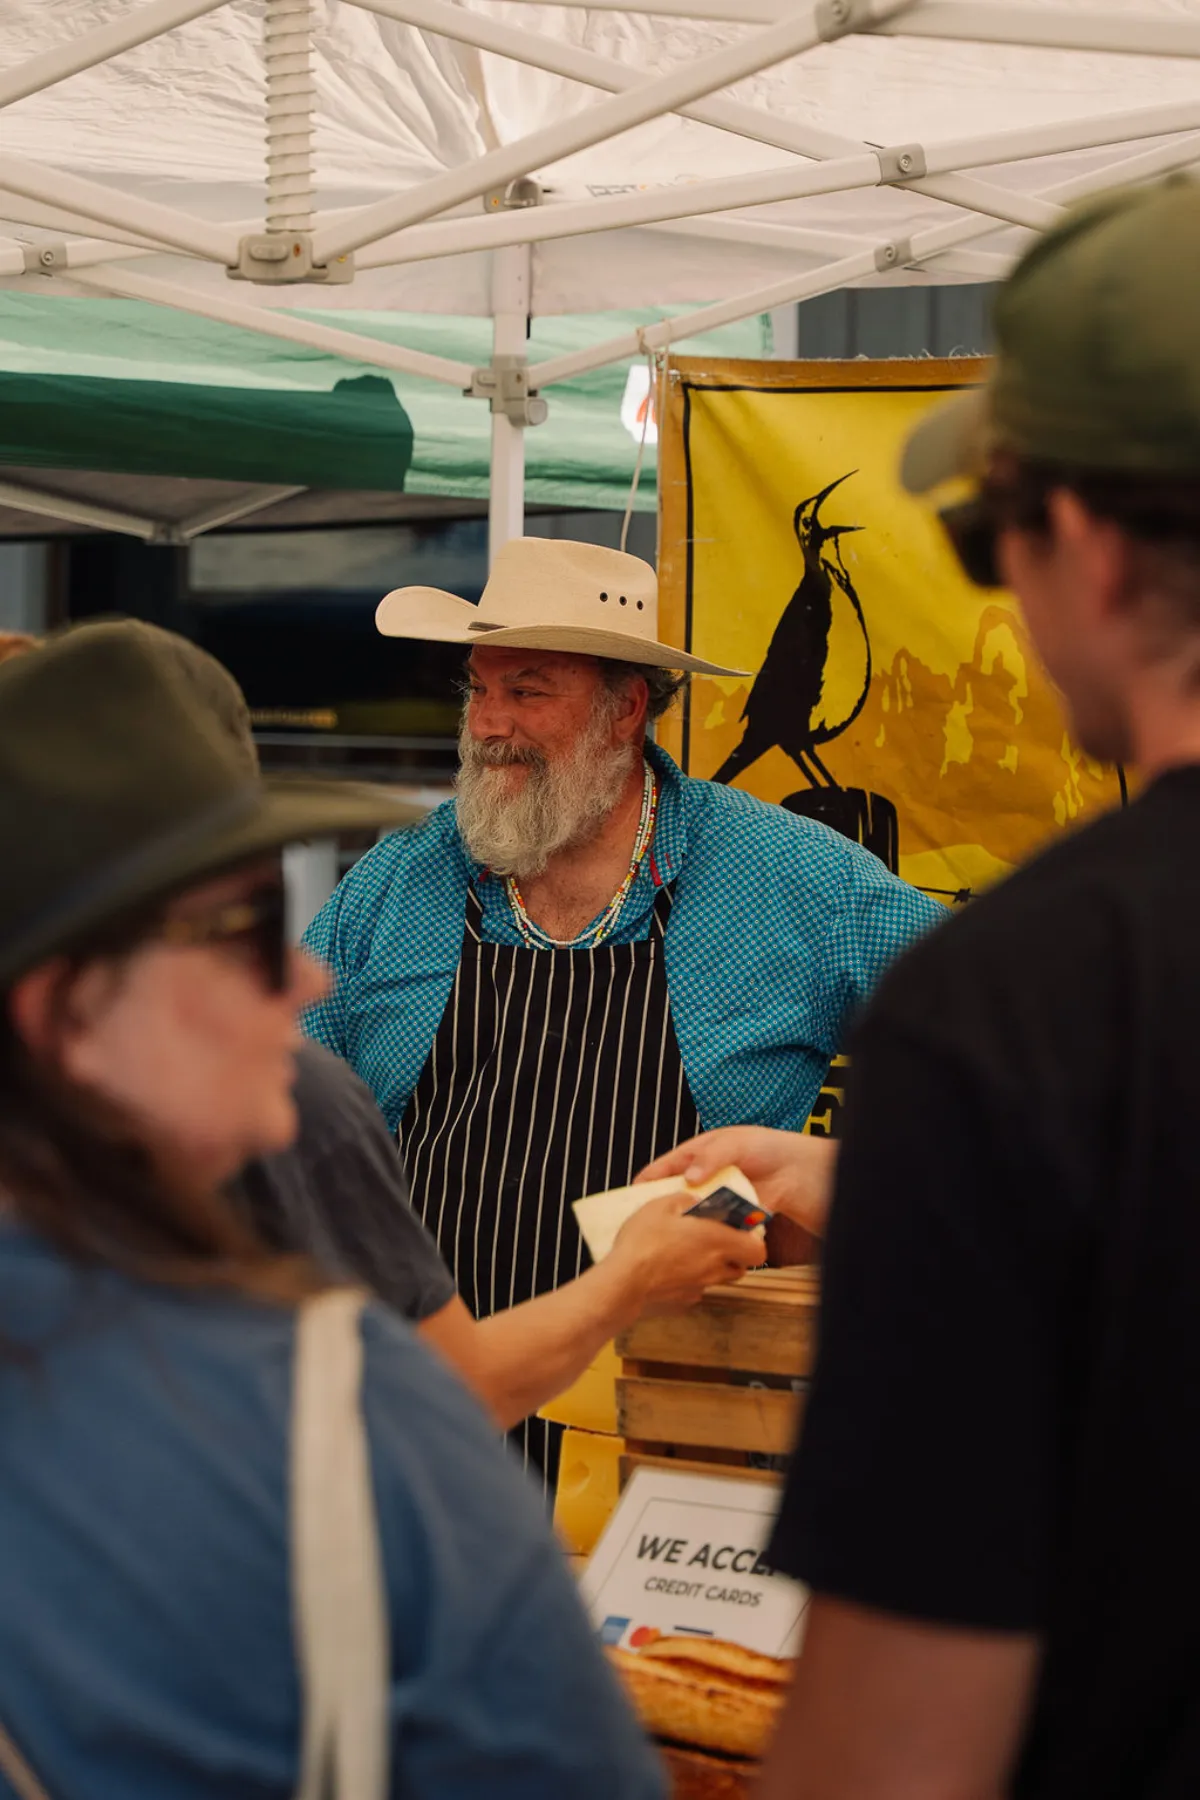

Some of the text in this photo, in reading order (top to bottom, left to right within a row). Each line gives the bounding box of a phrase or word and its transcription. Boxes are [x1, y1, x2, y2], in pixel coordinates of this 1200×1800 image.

[637, 1534, 688, 1564] WE
[644, 1576, 763, 1607] CREDIT CARDS
